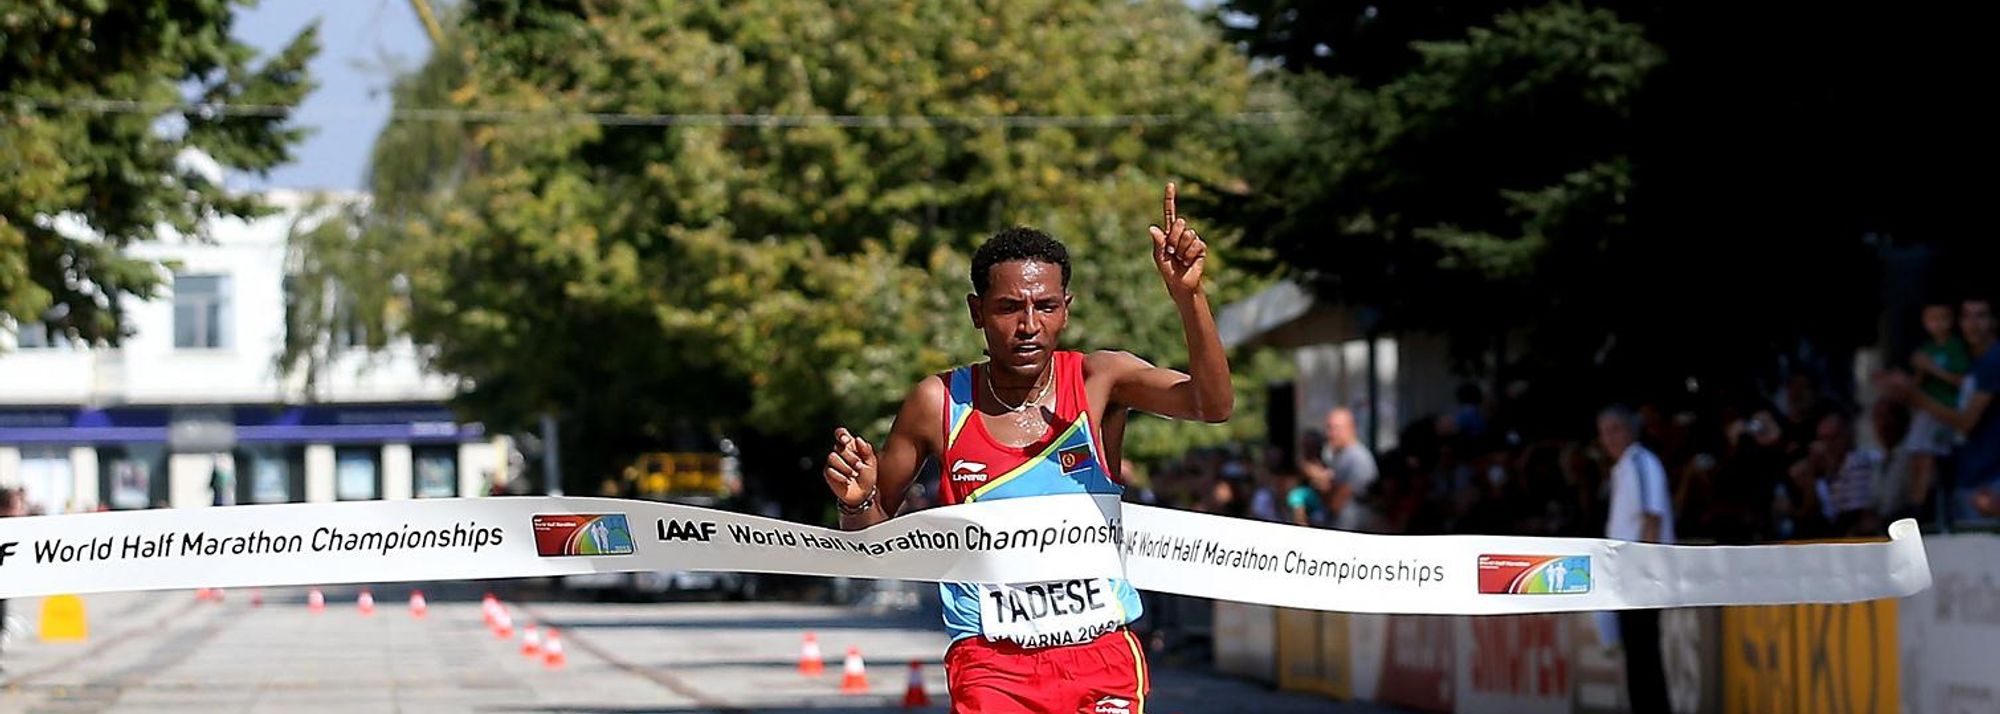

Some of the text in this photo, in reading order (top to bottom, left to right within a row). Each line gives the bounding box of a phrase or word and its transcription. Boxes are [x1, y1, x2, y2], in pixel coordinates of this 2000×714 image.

[34, 536, 114, 564] World
[121, 532, 175, 559] Half
[181, 530, 302, 557] Marathon
[311, 521, 504, 556] Championships
[657, 519, 717, 541] IAAF
[727, 523, 797, 546] World
[800, 532, 846, 551] Half
[846, 529, 959, 556] Marathon
[1138, 531, 1172, 559] World
[1171, 536, 1203, 563] Half
[1202, 540, 1279, 572] Marathon
[1284, 550, 1445, 587] Championships
[990, 578, 1105, 623] TADESE
[992, 631, 1075, 648] VARNA
